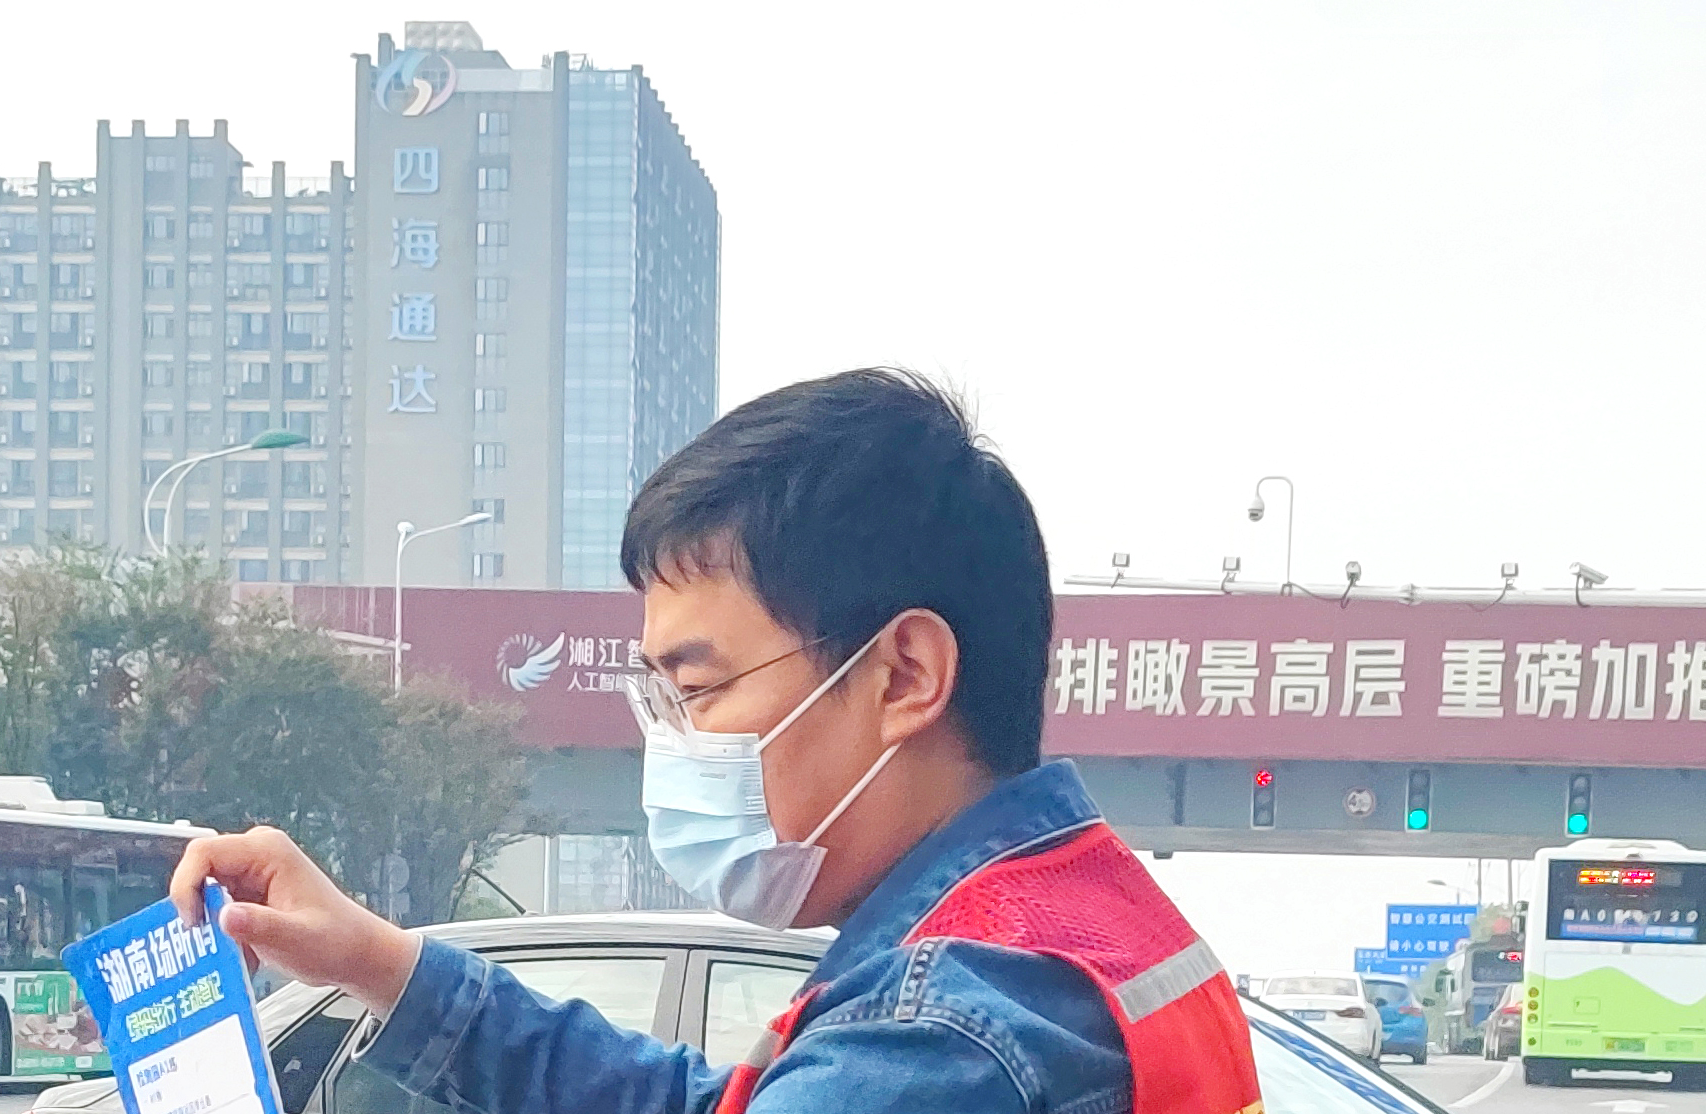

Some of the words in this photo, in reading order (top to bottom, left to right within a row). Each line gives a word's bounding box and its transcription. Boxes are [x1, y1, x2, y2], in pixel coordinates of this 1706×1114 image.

[388, 147, 440, 413] 四海通达
[1052, 638, 1407, 717] 排瞰景高层
